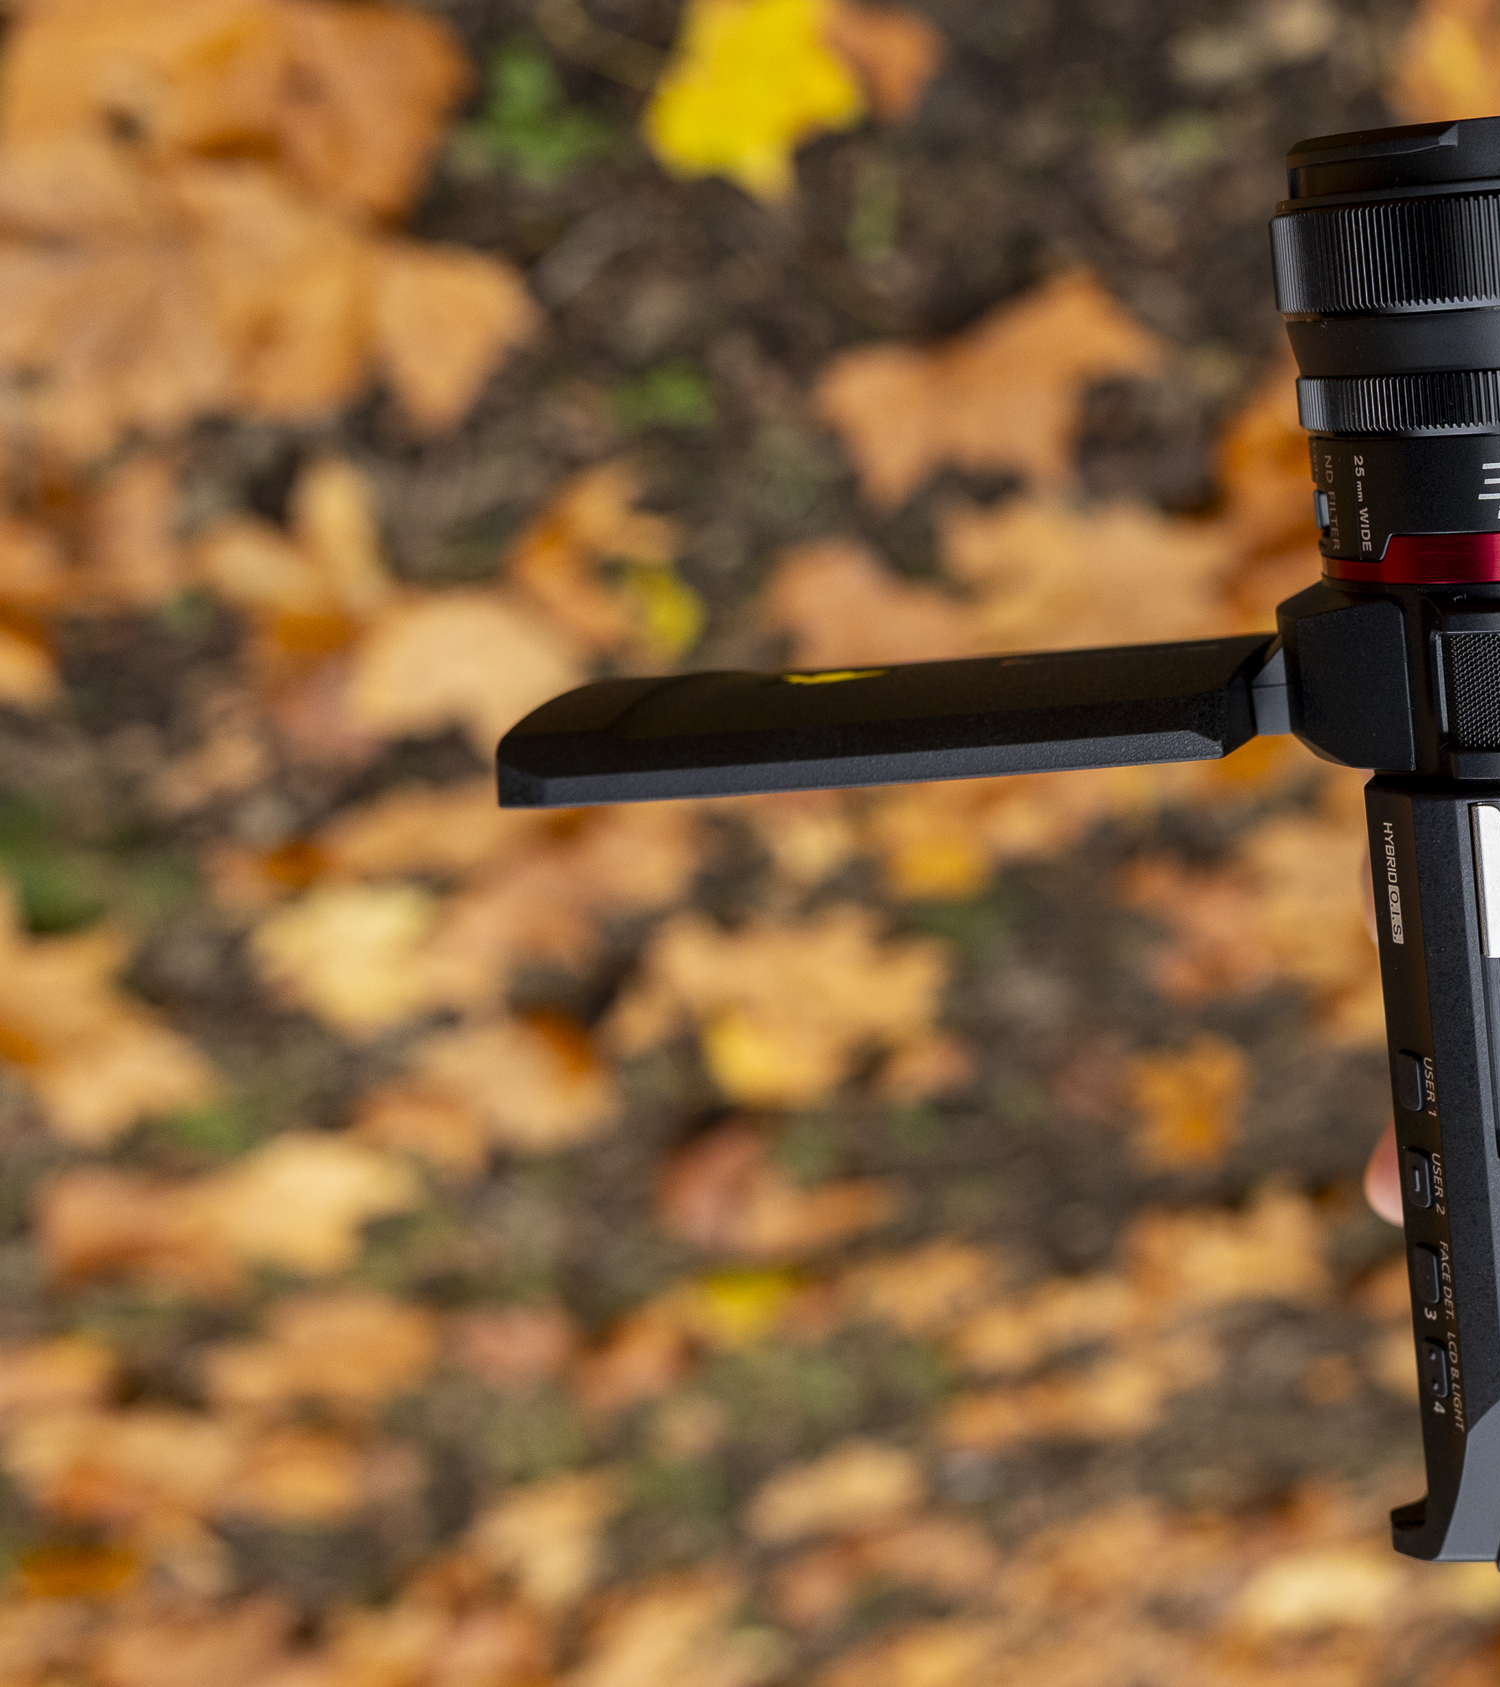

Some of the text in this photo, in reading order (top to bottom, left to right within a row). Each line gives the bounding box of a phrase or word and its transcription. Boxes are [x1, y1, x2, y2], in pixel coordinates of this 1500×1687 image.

[1324, 455, 1340, 551] ND FILTER
[1353, 455, 1372, 551] 25 mm WIDE
[1383, 822, 1403, 943] HYBRID O.I.S.
[1423, 1056, 1436, 1102] USER
[1432, 1153, 1445, 1215] USER 2
[1439, 1240, 1454, 1320] FACE DET.
[1424, 1307, 1437, 1321] 3
[1447, 1331, 1458, 1364] LCD
[1433, 1401, 1446, 1415] 4
